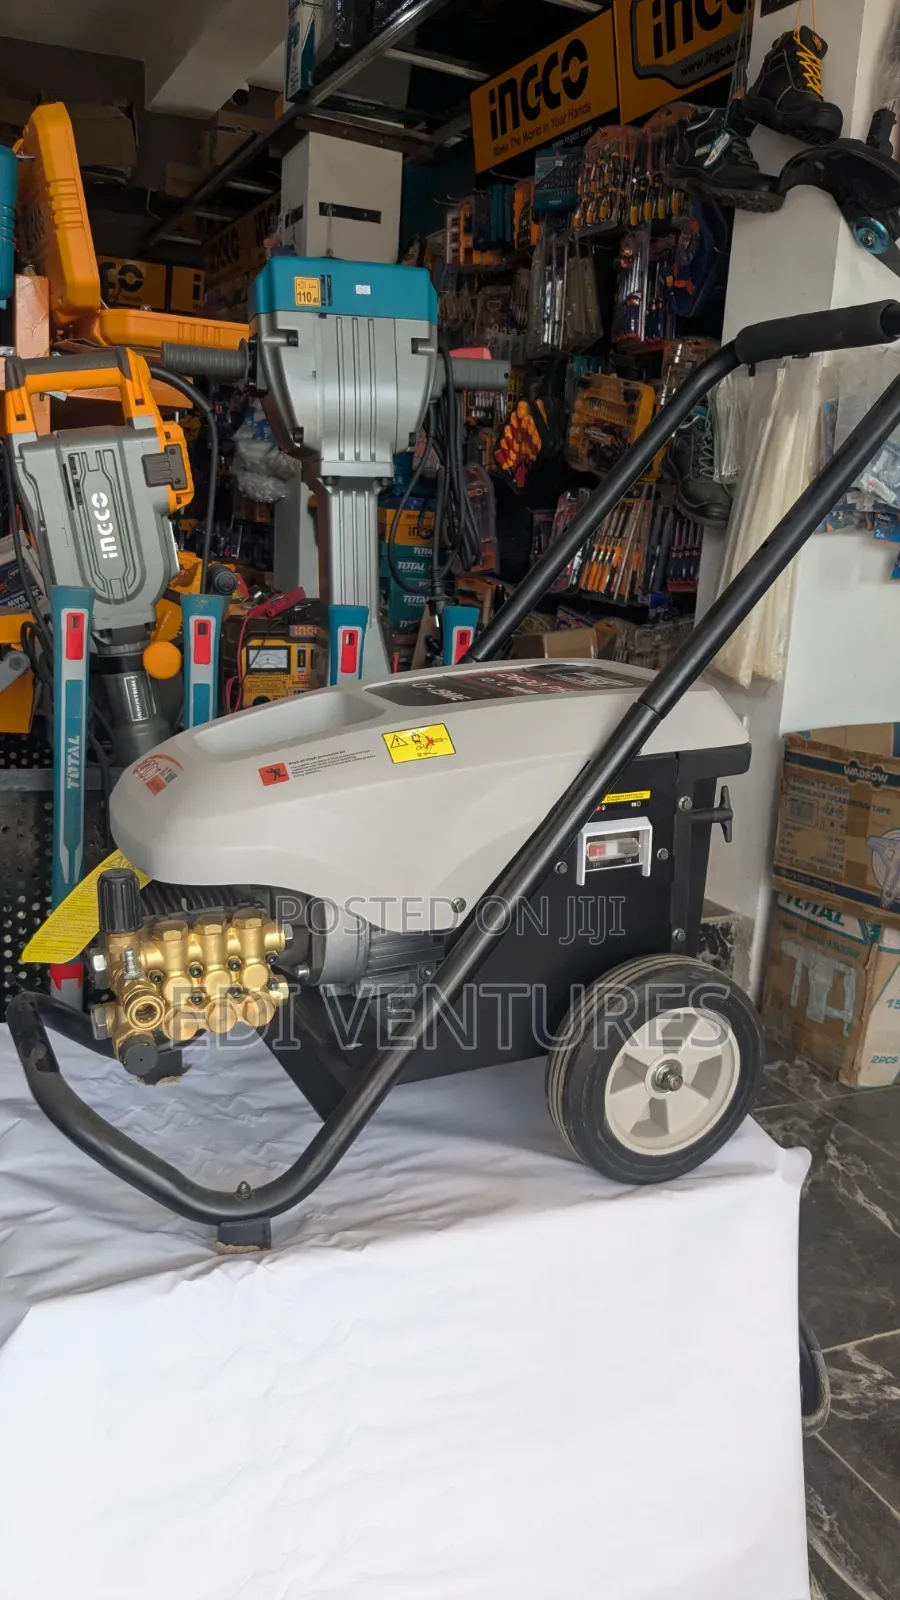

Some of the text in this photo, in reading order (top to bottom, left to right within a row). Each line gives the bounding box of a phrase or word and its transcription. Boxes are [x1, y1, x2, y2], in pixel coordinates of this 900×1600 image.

[510, 135, 522, 149] The
[522, 126, 542, 144] World
[550, 114, 567, 129] Your
[568, 102, 592, 121] Hands
[297, 291, 312, 303] 110
[413, 547, 433, 556] TOTA
[397, 561, 426, 571] TOTAL
[67, 735, 80, 789] TOTAL
[843, 765, 888, 783] WADFOW
[872, 804, 890, 815] TAPE
[871, 1055, 899, 1064] 2PCS
